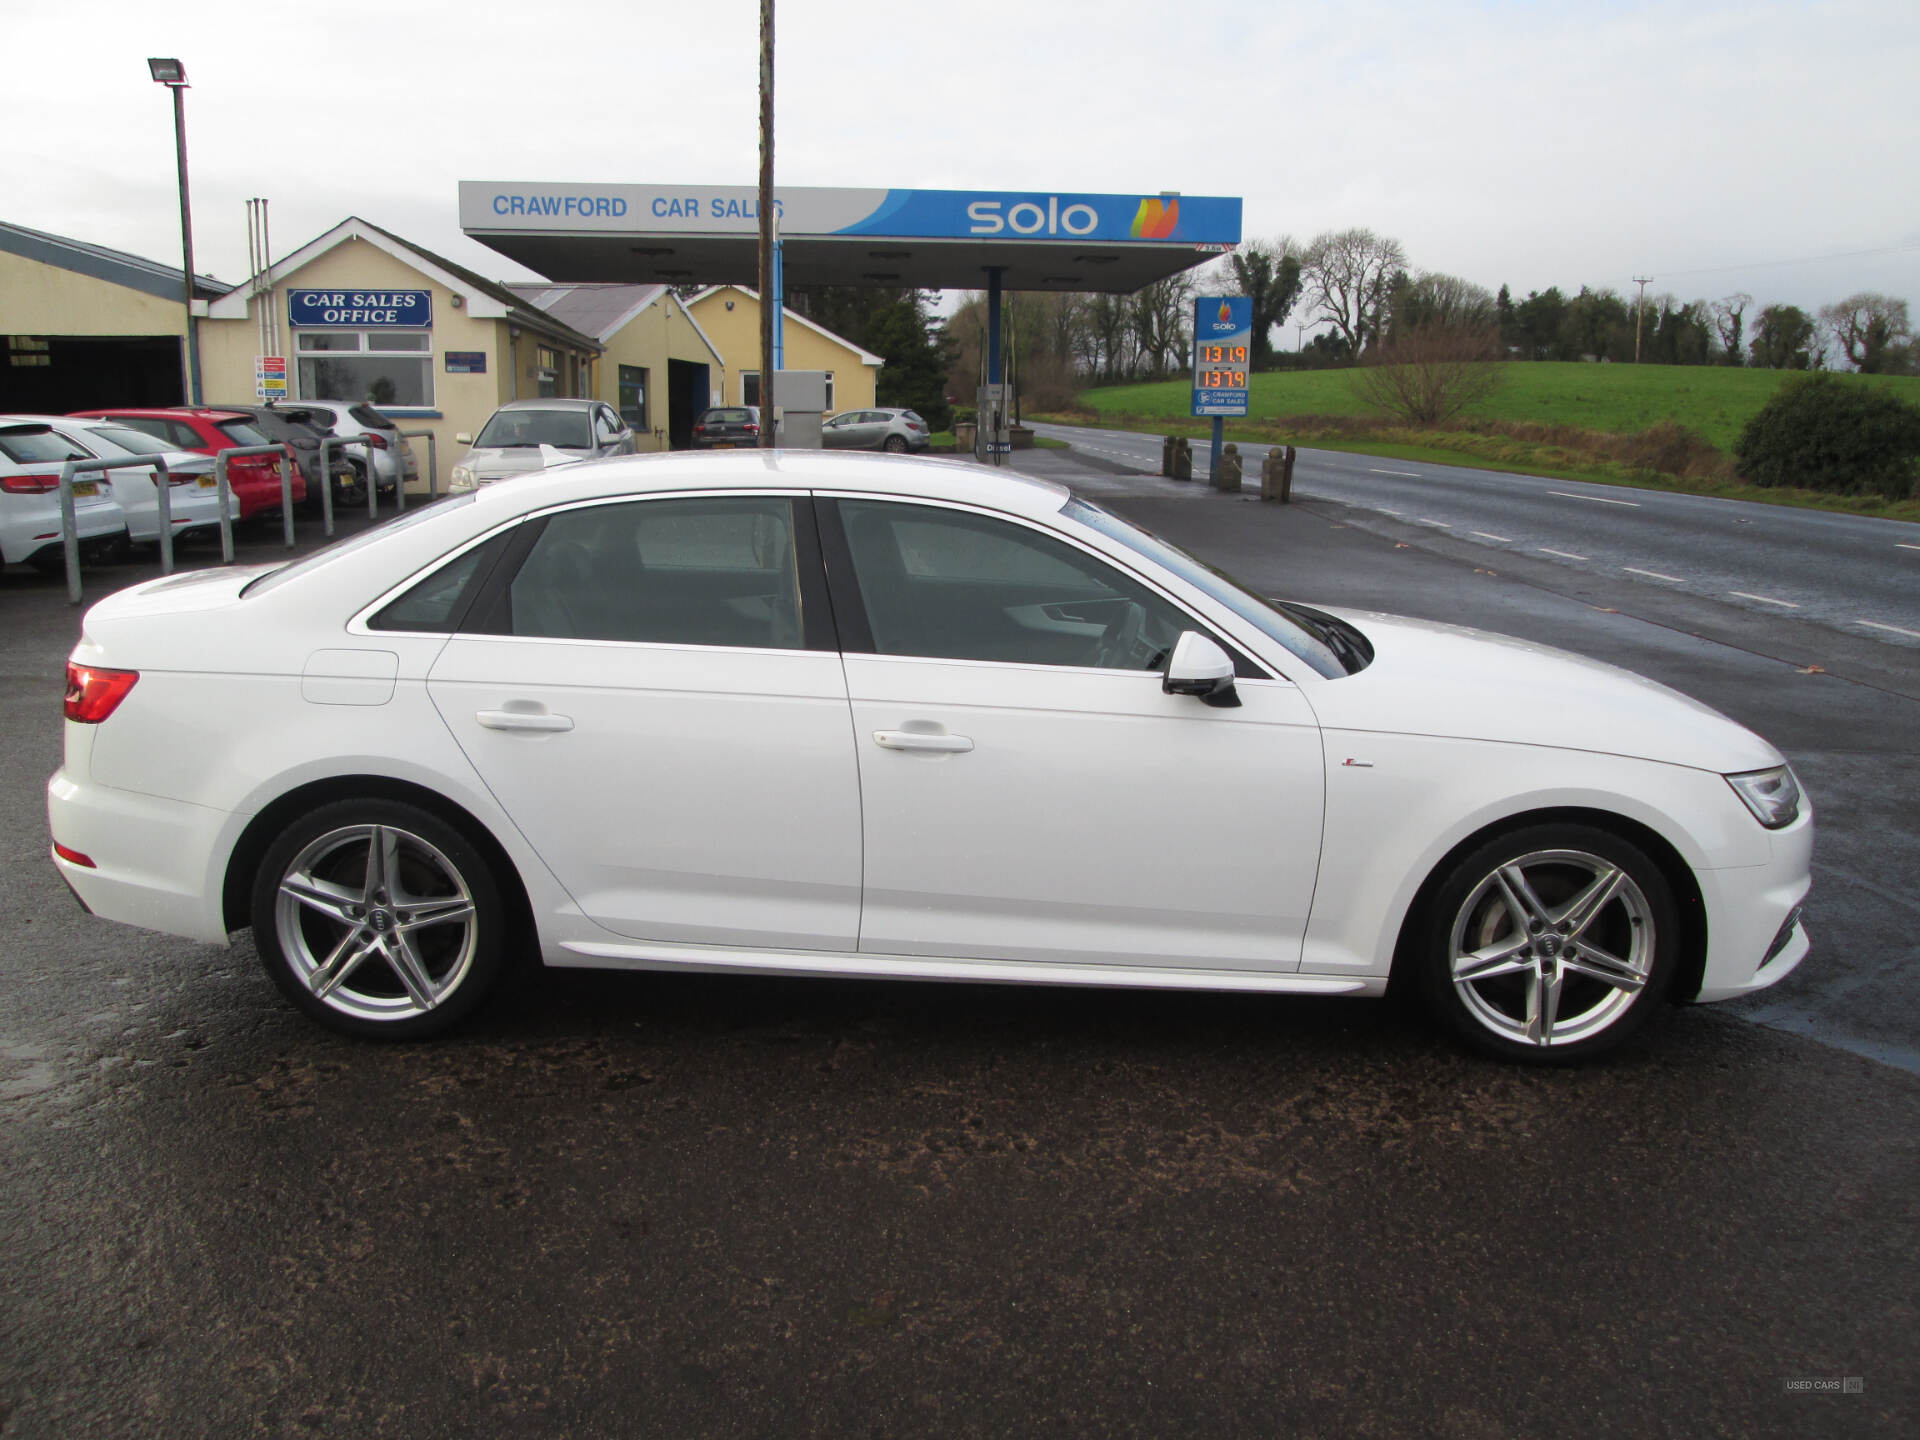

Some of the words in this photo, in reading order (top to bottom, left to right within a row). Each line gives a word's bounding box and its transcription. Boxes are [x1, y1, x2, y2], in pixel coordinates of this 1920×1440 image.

[493, 195, 627, 217] CRAWFORD
[651, 197, 699, 218] CAR
[711, 198, 784, 219] SALS
[967, 197, 1098, 235] solo
[303, 294, 346, 307] CAR
[352, 294, 416, 307] SALES
[323, 309, 397, 322] OFFICE
[1204, 371, 1245, 388] 137.9
